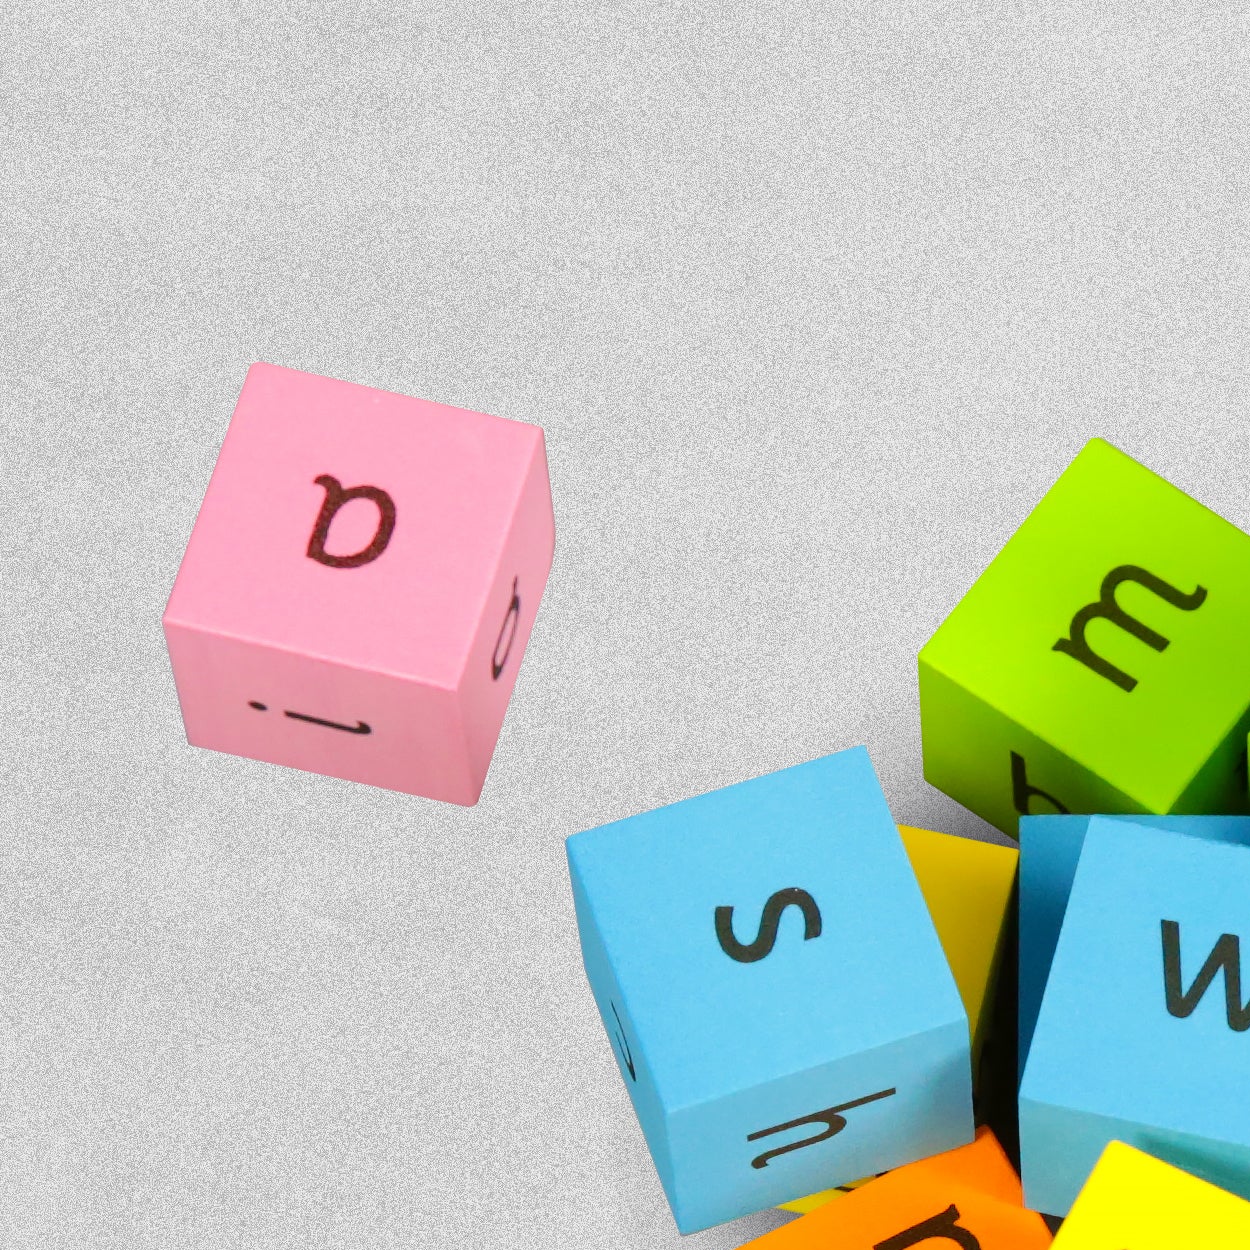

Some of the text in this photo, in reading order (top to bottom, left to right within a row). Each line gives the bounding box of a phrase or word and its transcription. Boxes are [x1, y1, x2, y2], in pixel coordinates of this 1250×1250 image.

[306, 470, 398, 570] a
[1050, 562, 1210, 695] m
[713, 885, 824, 966] s
[745, 1085, 898, 1171] h
